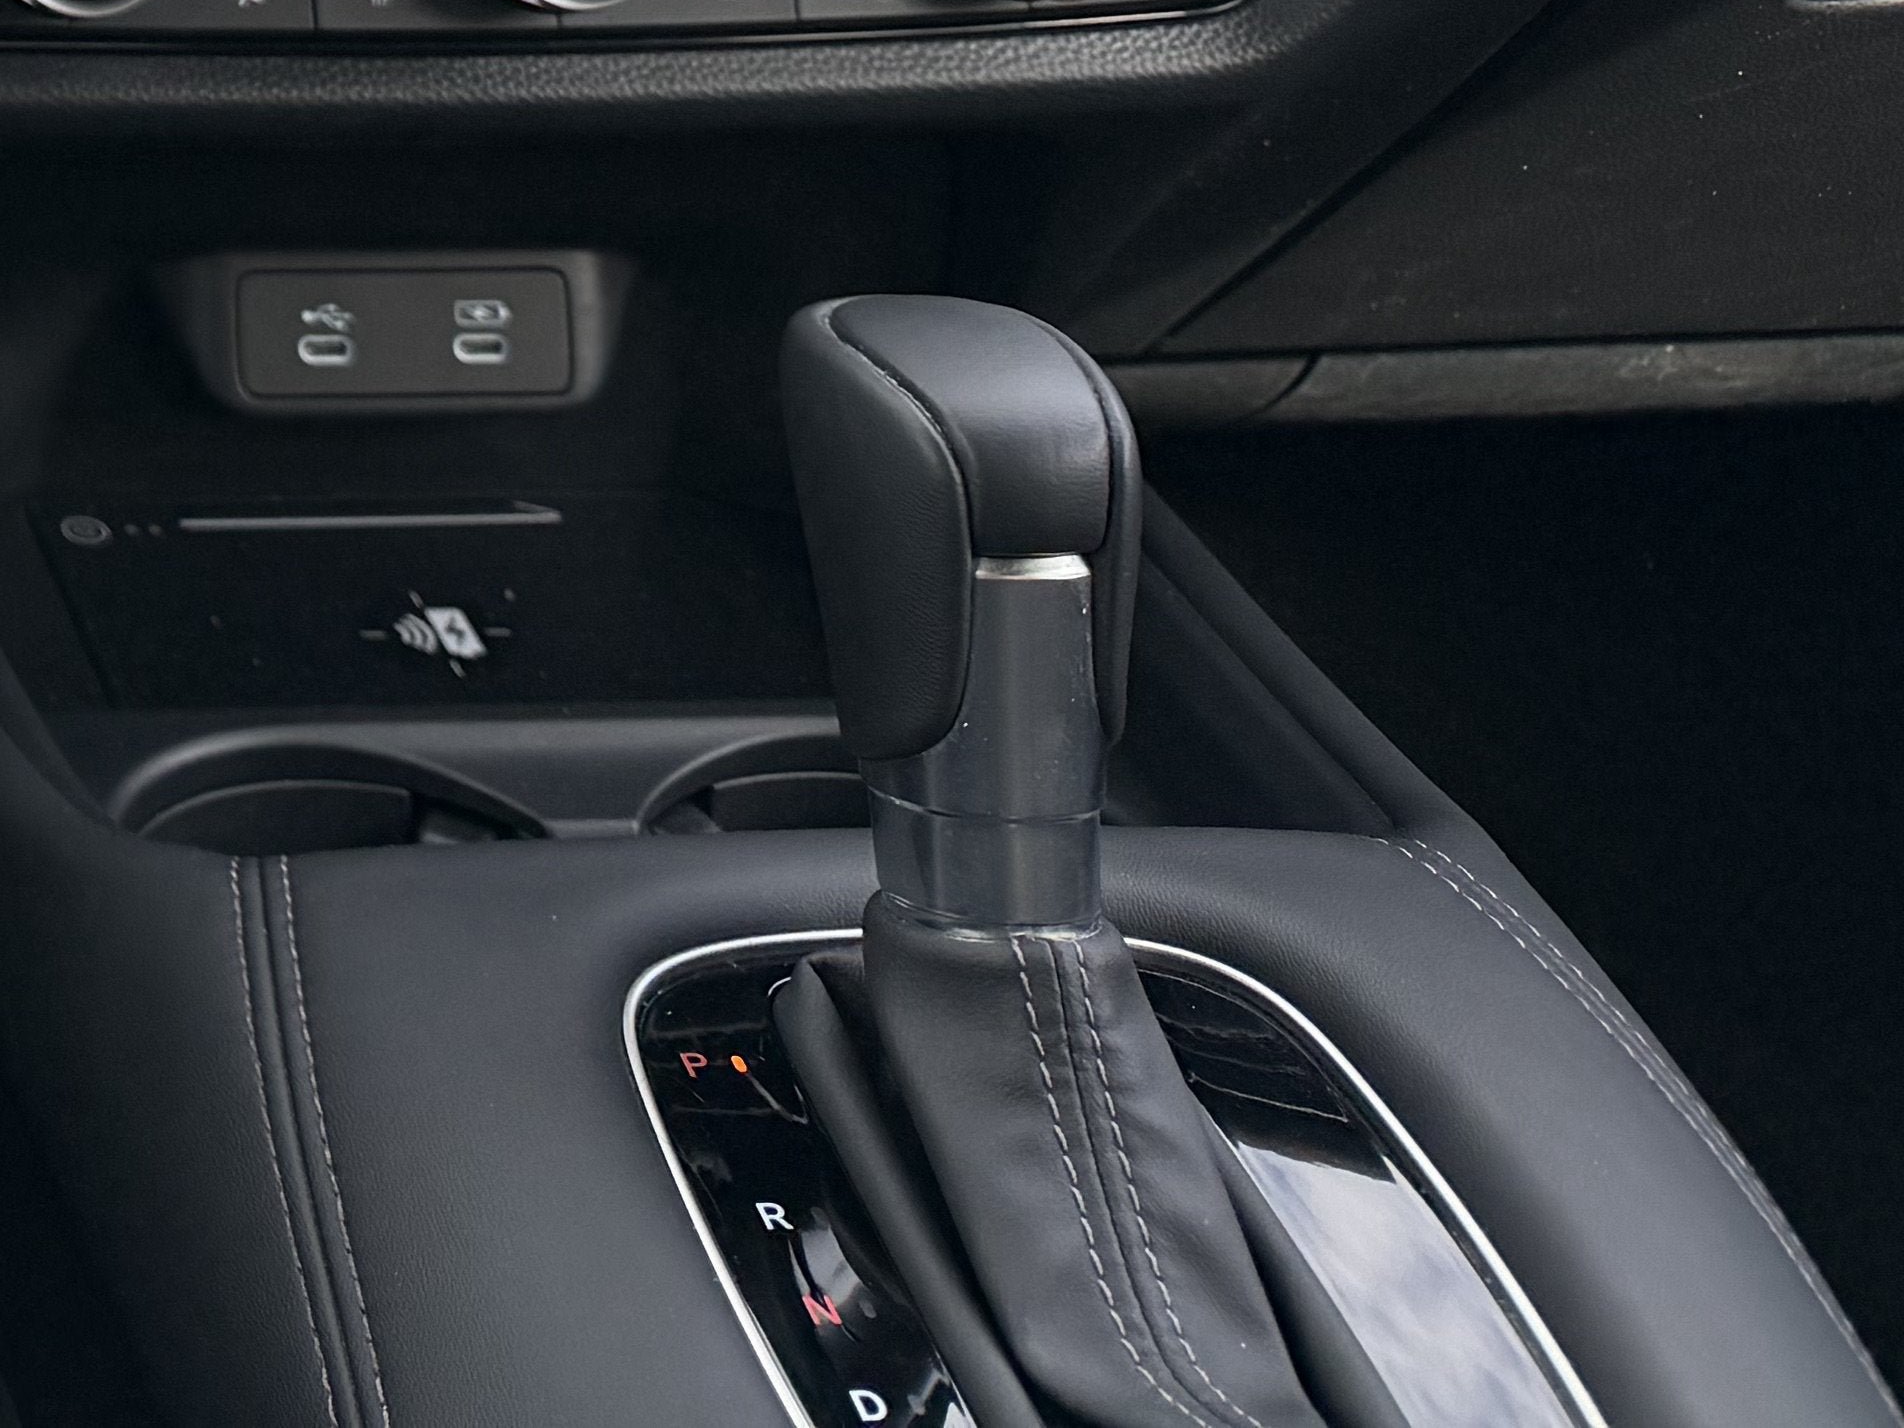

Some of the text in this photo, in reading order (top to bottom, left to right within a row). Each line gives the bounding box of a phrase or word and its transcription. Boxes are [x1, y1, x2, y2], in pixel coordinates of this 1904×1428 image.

[678, 1051, 710, 1080] P
[754, 1201, 796, 1231] R
[800, 1293, 844, 1327] N
[847, 1388, 890, 1424] D
